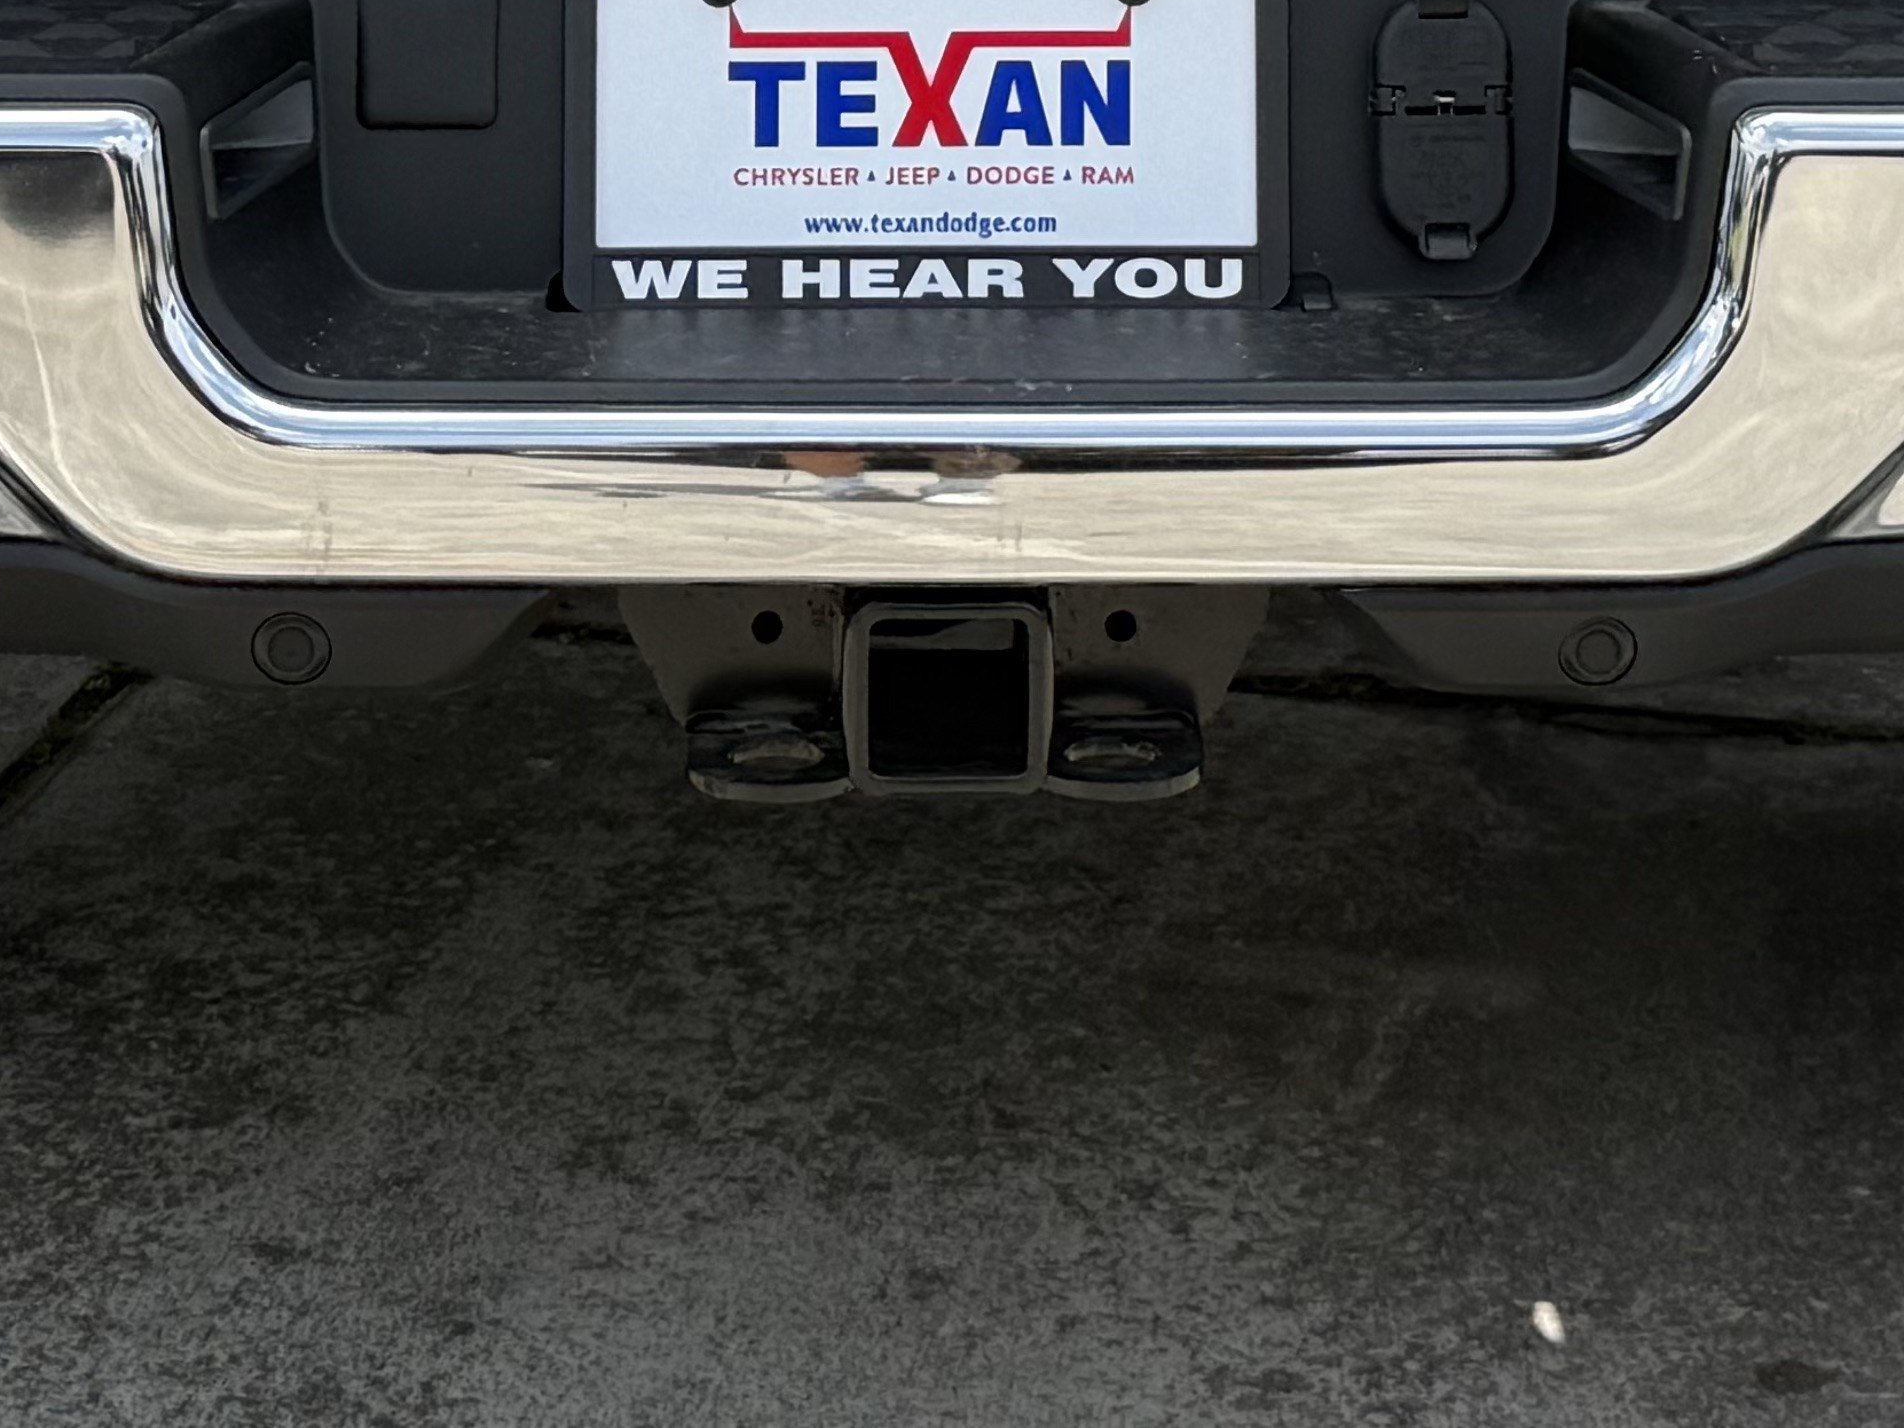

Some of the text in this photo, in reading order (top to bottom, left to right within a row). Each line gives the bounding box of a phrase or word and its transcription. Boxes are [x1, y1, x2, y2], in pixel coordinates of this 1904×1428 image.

[728, 7, 1132, 148] TEXAN
[733, 165, 1134, 187] CHRYSLER JEEP DODGE RAM
[803, 211, 1057, 240] www.texandodge.com
[611, 257, 1243, 300] WE HEAR YOU
